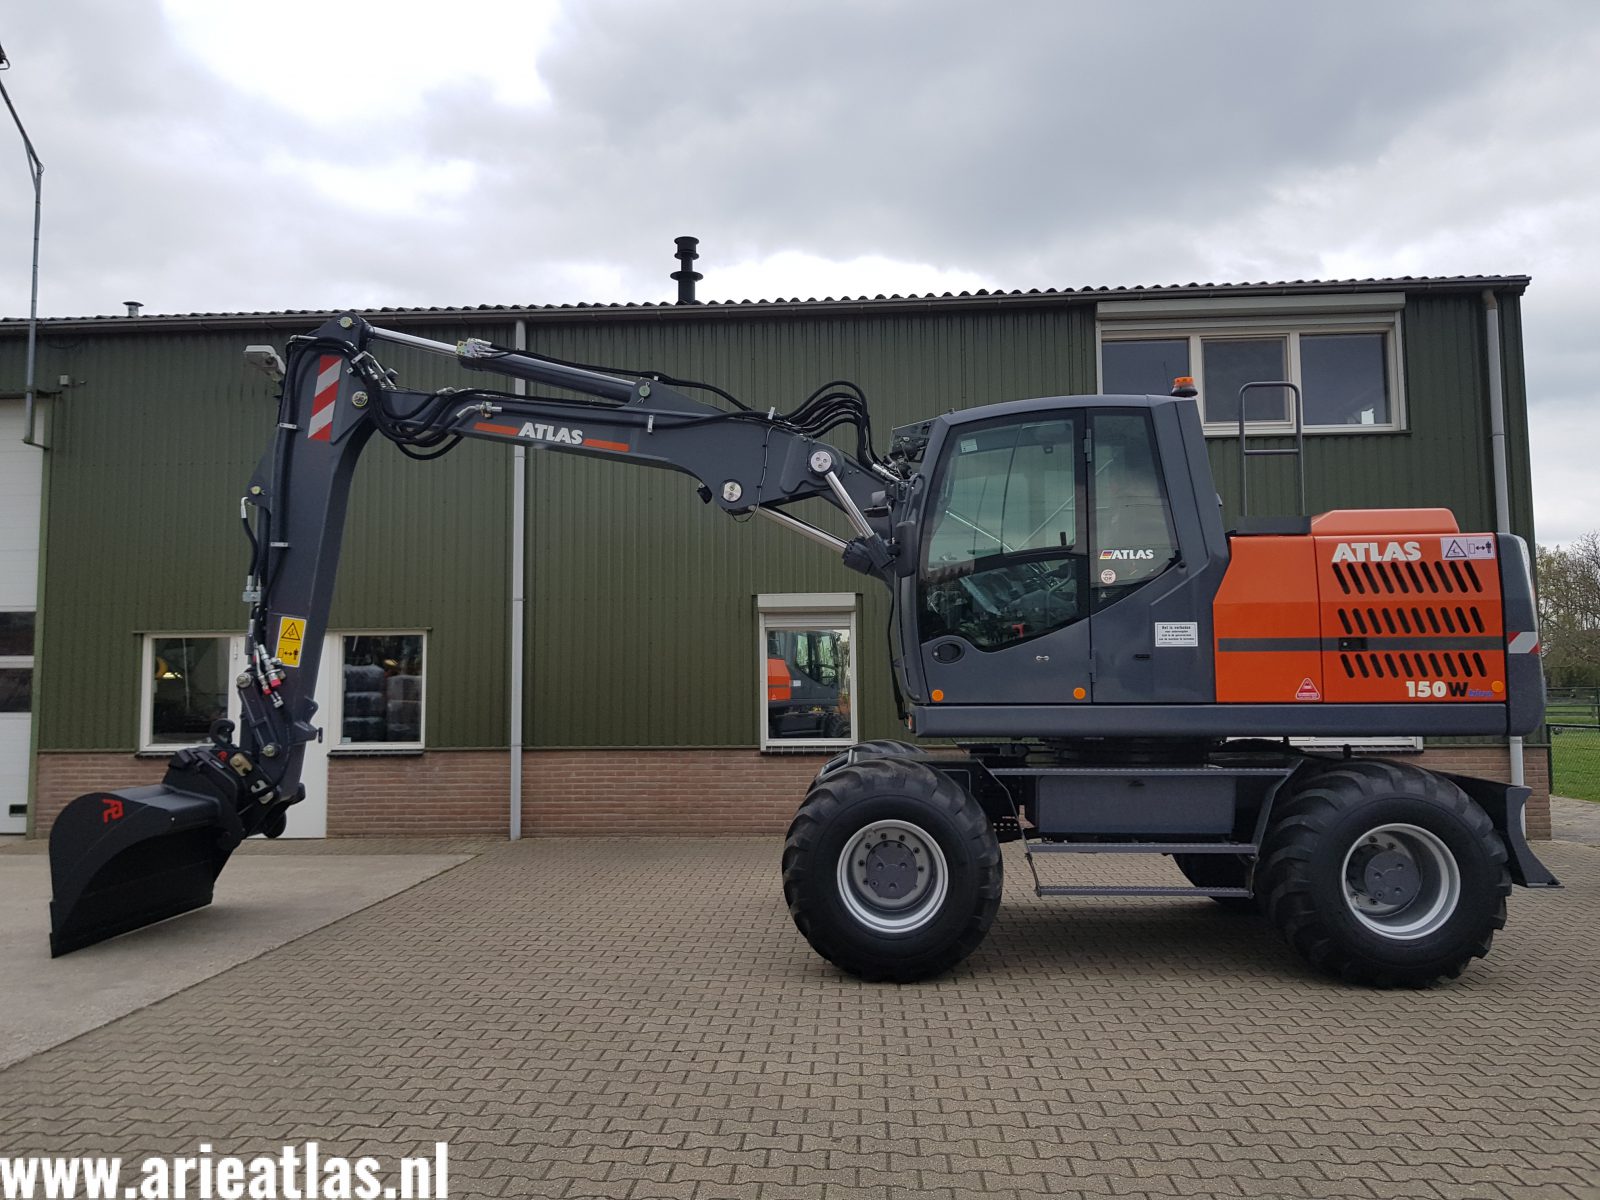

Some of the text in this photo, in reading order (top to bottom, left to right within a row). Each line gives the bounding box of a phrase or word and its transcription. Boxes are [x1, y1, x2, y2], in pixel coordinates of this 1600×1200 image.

[518, 422, 583, 445] ATLAS
[1111, 549, 1154, 560] ATLAS
[1331, 541, 1422, 563] ATLAS
